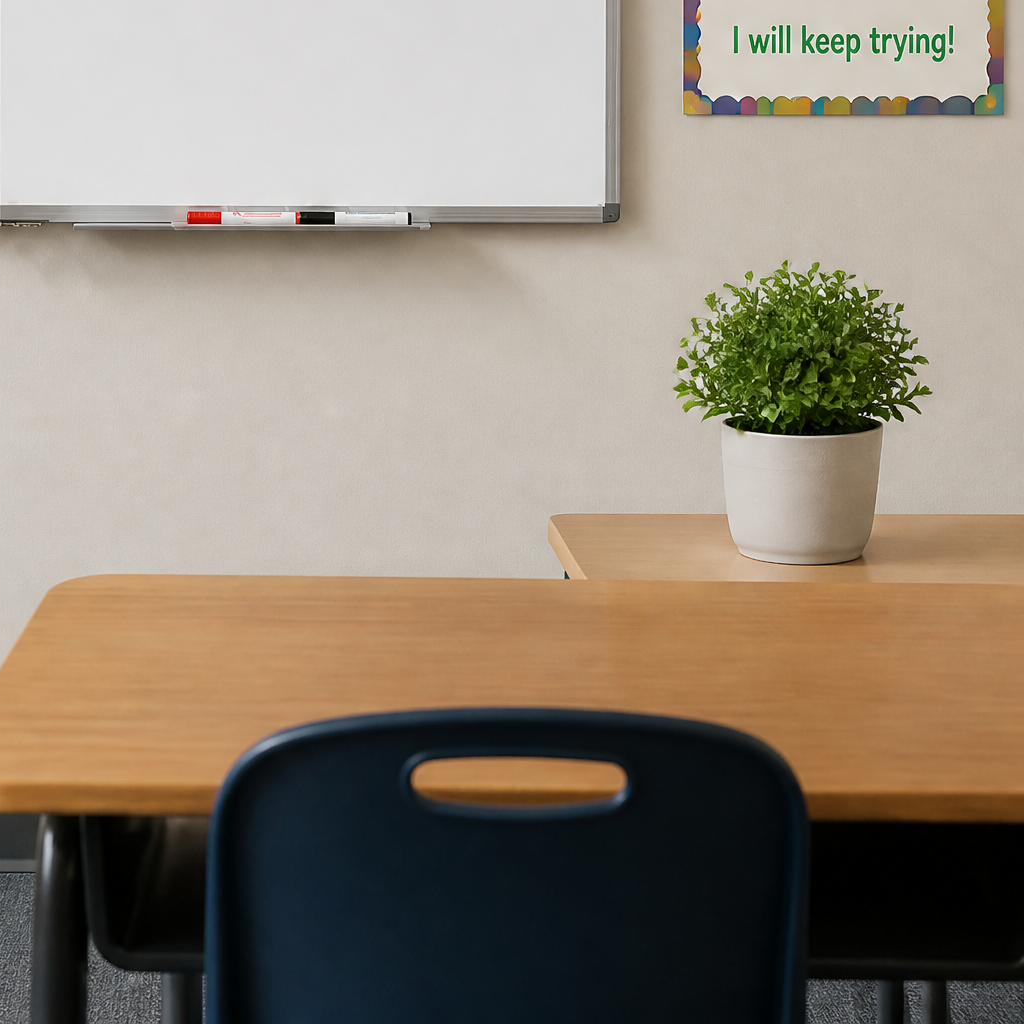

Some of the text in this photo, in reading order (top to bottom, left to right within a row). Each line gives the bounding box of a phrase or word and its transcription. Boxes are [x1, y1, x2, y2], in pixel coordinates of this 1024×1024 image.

[732, 25, 954, 63] I will keep trying!
